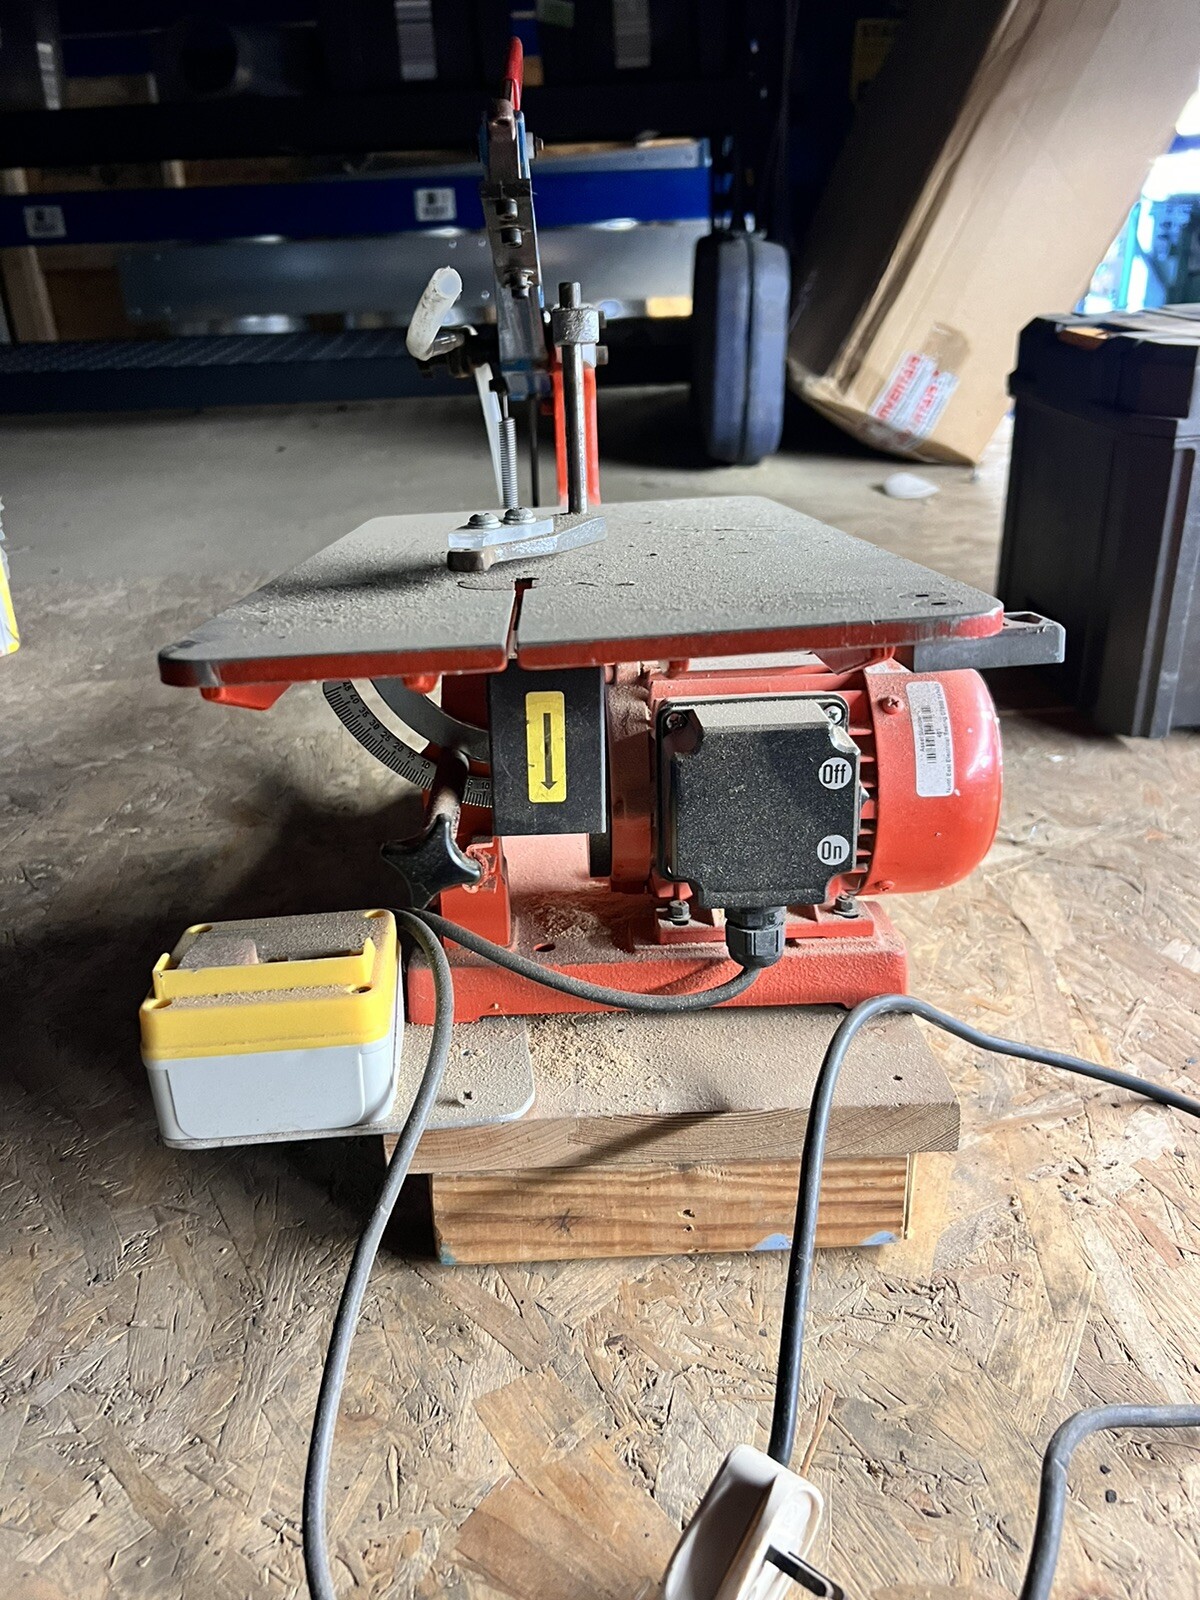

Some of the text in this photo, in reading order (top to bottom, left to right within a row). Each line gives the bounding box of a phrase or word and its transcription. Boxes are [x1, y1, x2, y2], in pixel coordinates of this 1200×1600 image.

[342, 681, 431, 770] 45 40 35 30 25 20 15 10
[822, 763, 846, 784] Off
[821, 841, 842, 860] On
